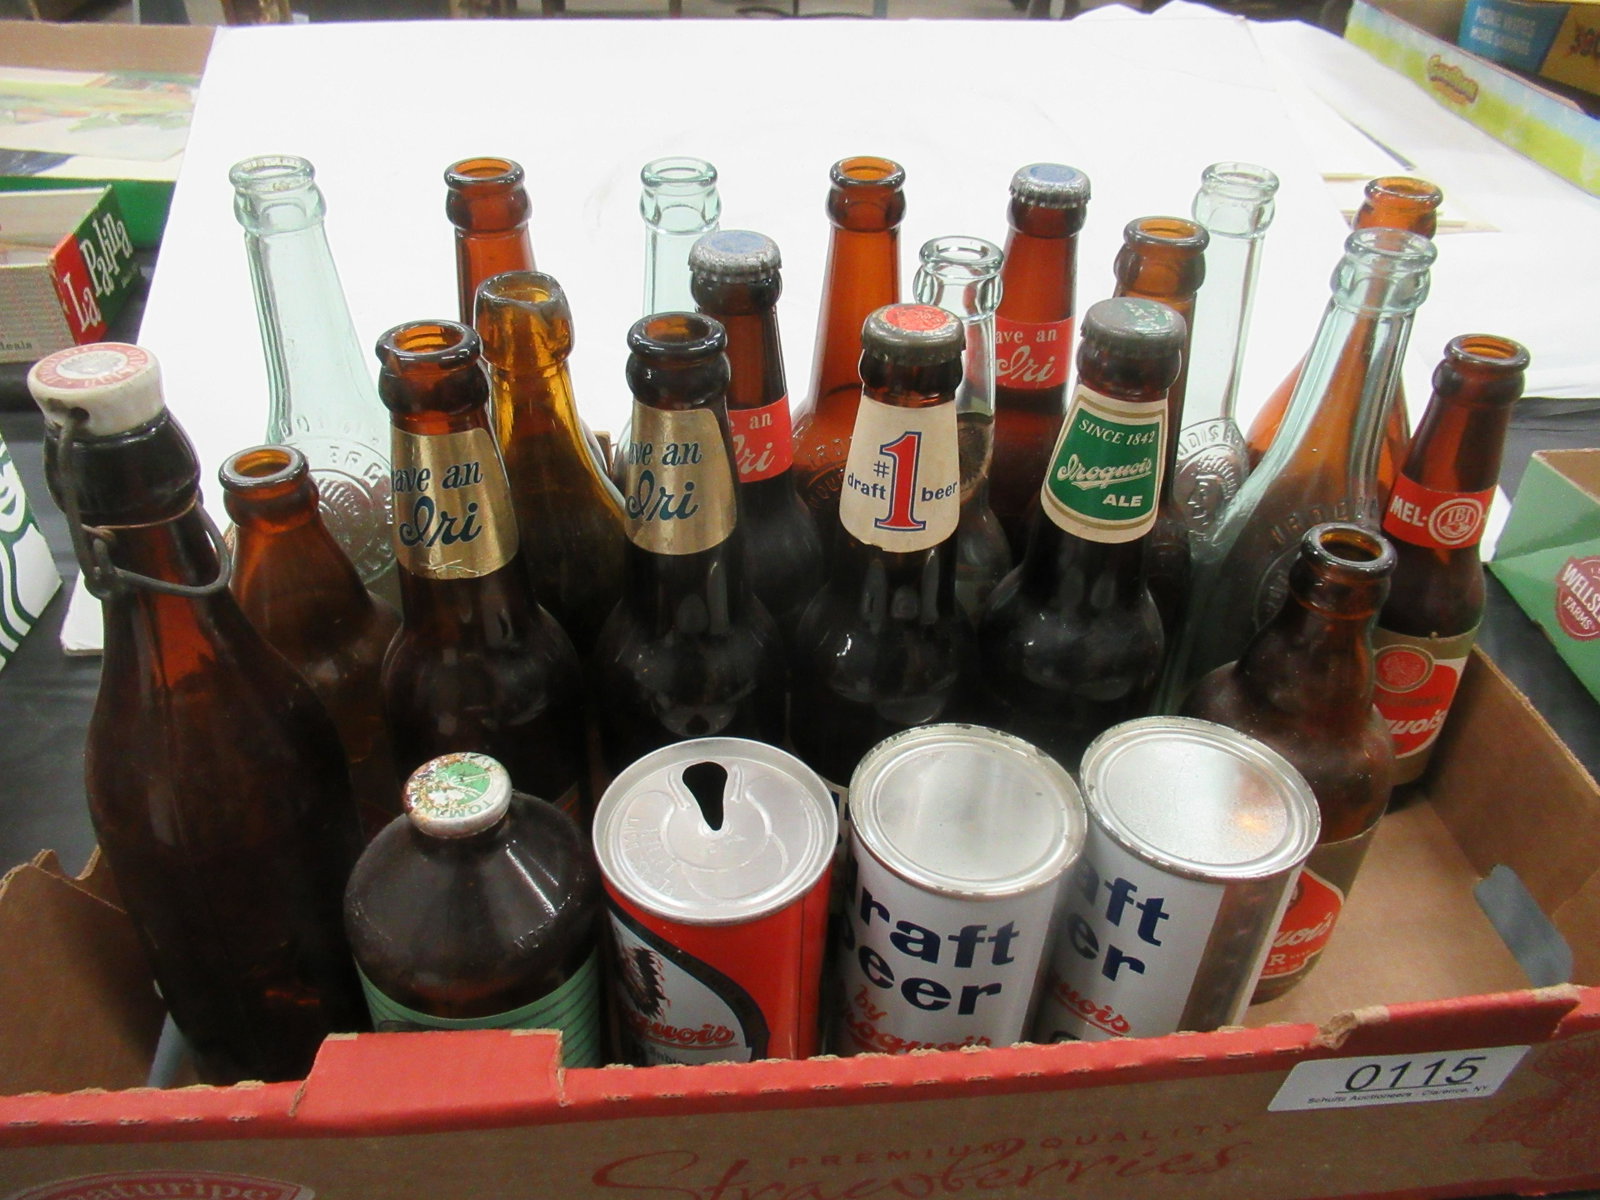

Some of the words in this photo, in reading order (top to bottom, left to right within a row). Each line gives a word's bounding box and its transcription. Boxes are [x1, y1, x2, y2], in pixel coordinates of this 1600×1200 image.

[63, 271, 102, 332] La
[996, 331, 1023, 344] ave
[1036, 328, 1058, 343] an
[749, 412, 772, 429] an
[1079, 418, 1124, 445] SINCE
[1127, 430, 1156, 446] 1842
[662, 441, 703, 467] an
[391, 468, 431, 494] ave
[442, 461, 484, 490] an
[847, 472, 887, 501] draft
[920, 481, 958, 502] beer
[878, 431, 926, 531] 1
[1057, 453, 1153, 491] Iroquois
[1102, 493, 1143, 508] ALE
[1563, 596, 1593, 630] FARMS
[858, 912, 1002, 1015] eer
[1345, 1056, 1487, 1092] 0115
[788, 1142, 1018, 1169] PREMIUM
[1040, 1121, 1244, 1150] QUALITY
